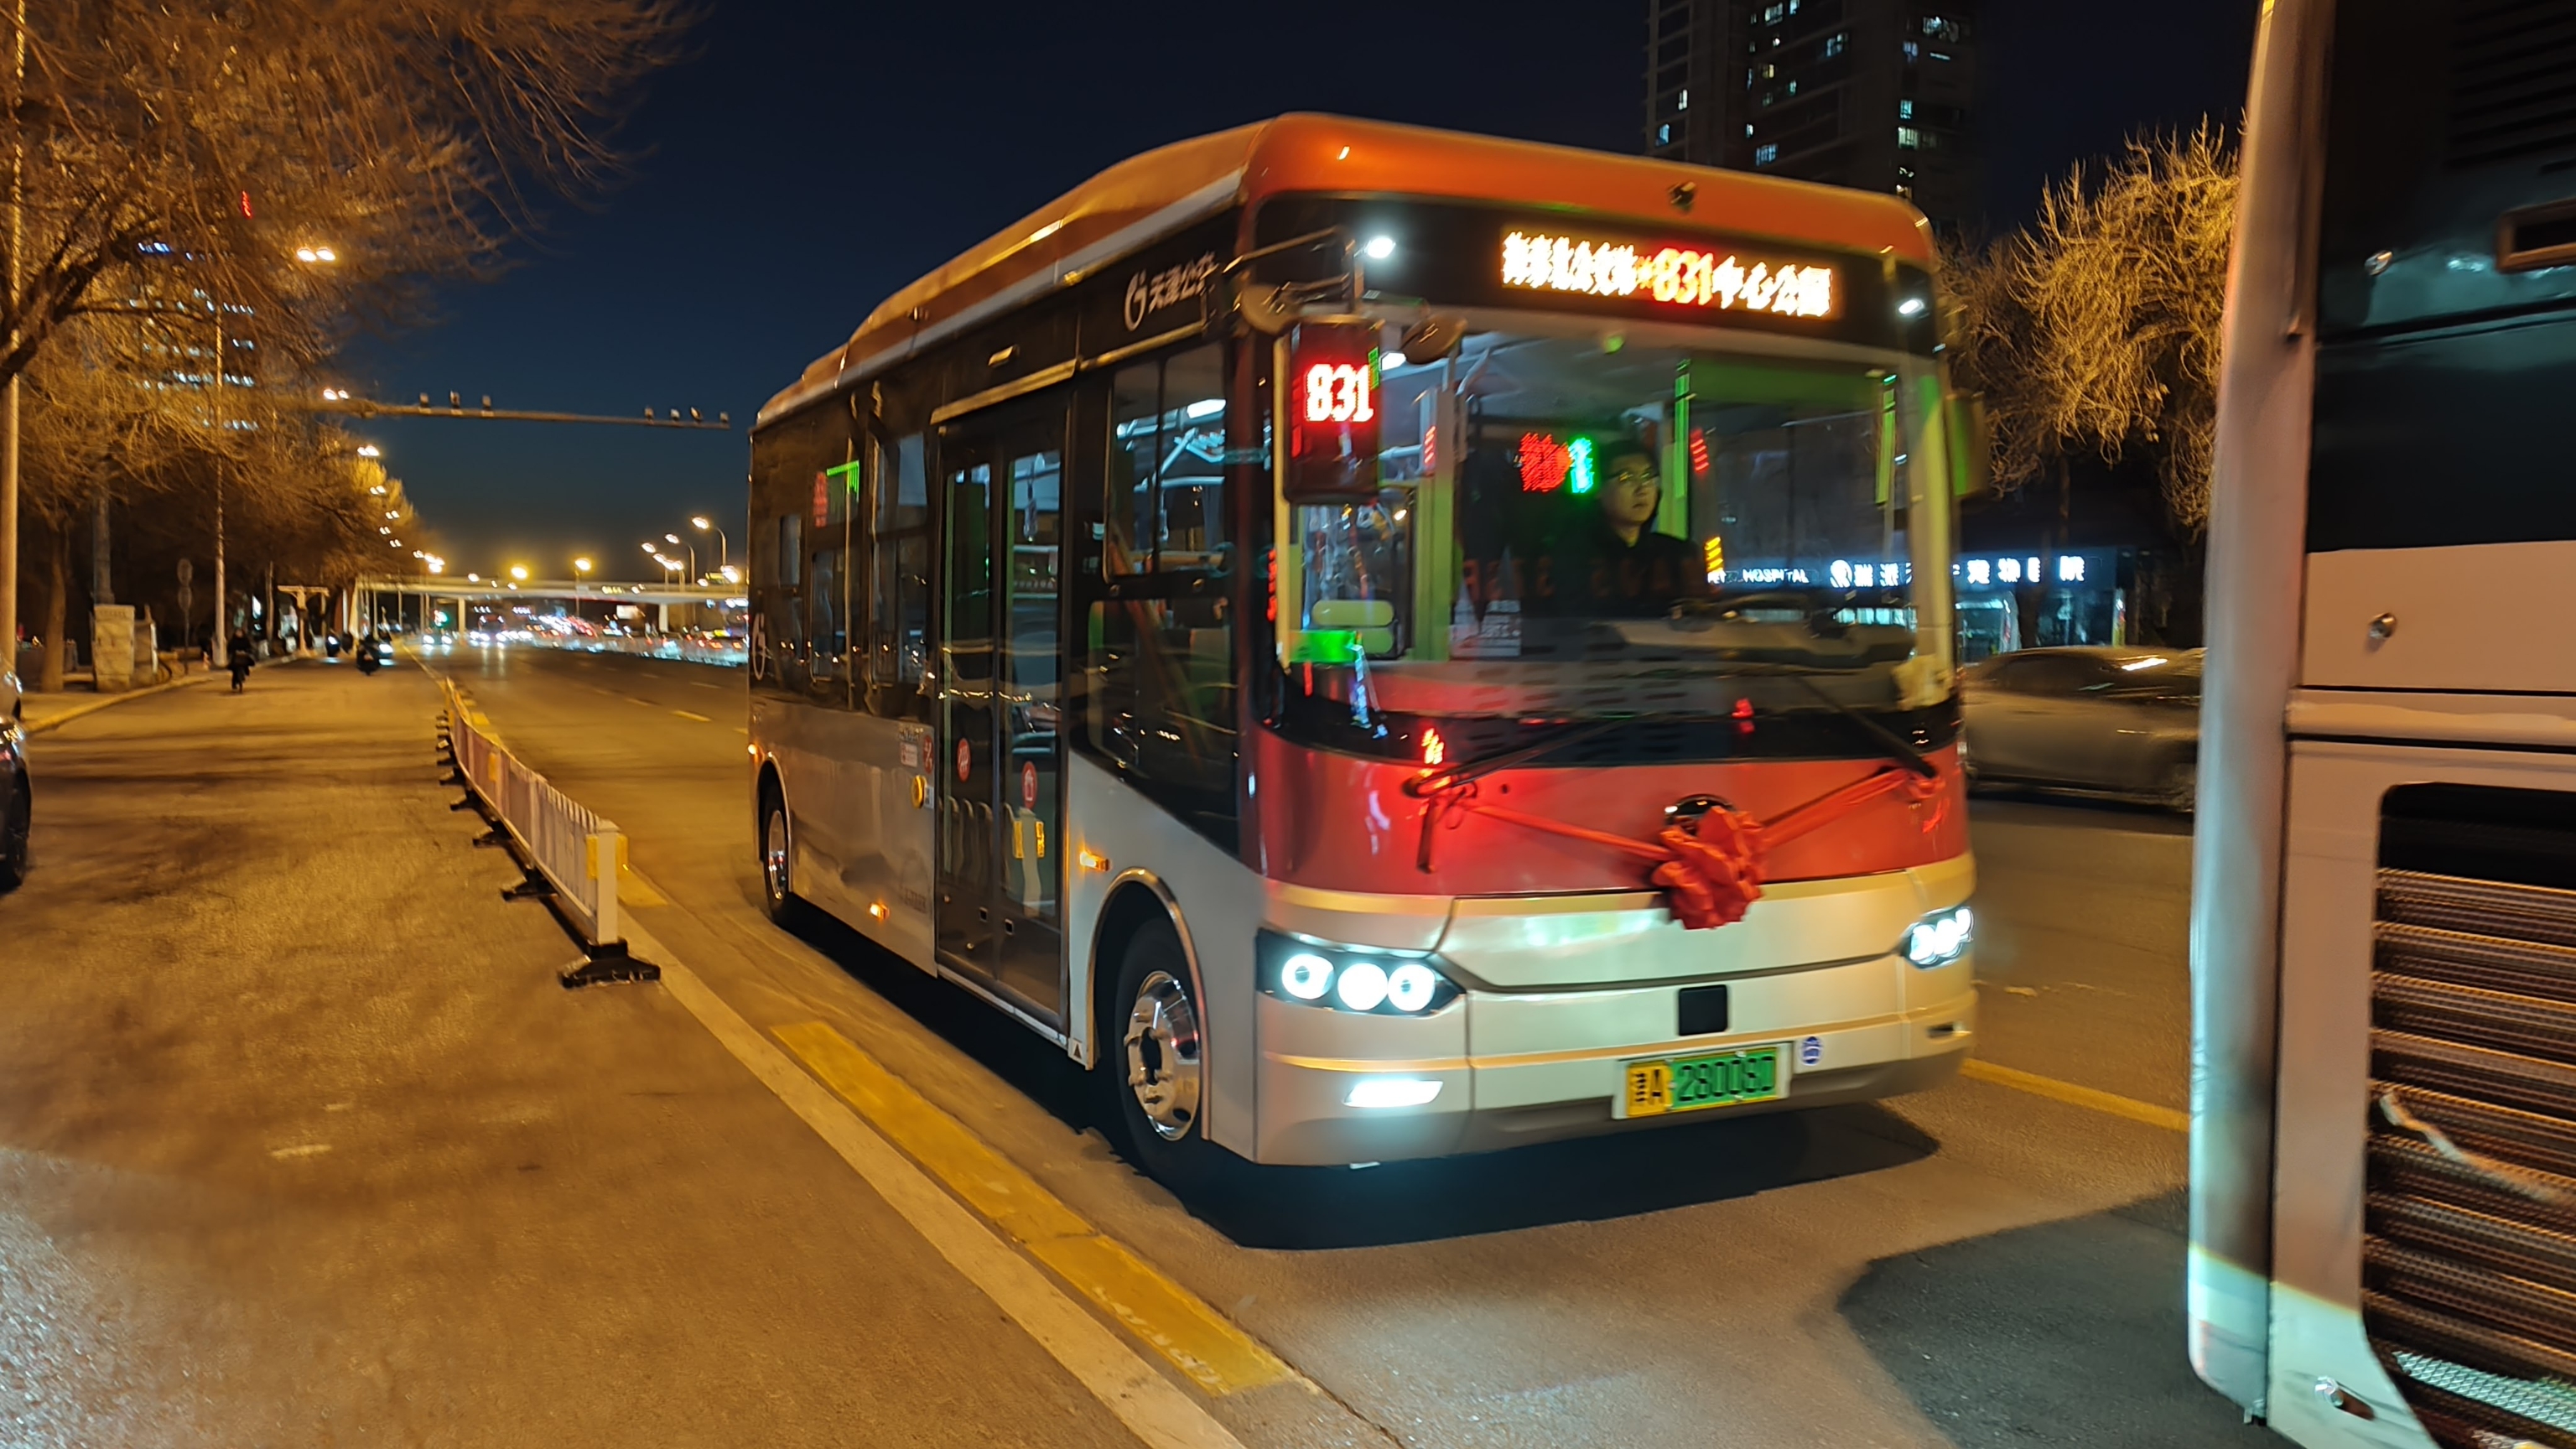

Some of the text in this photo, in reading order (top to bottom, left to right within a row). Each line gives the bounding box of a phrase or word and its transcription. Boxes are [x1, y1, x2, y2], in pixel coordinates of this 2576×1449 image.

[1713, 255, 1832, 318] 中心公园
[1306, 363, 1374, 423] 831
[1742, 568, 1810, 584] HOSPITAL
